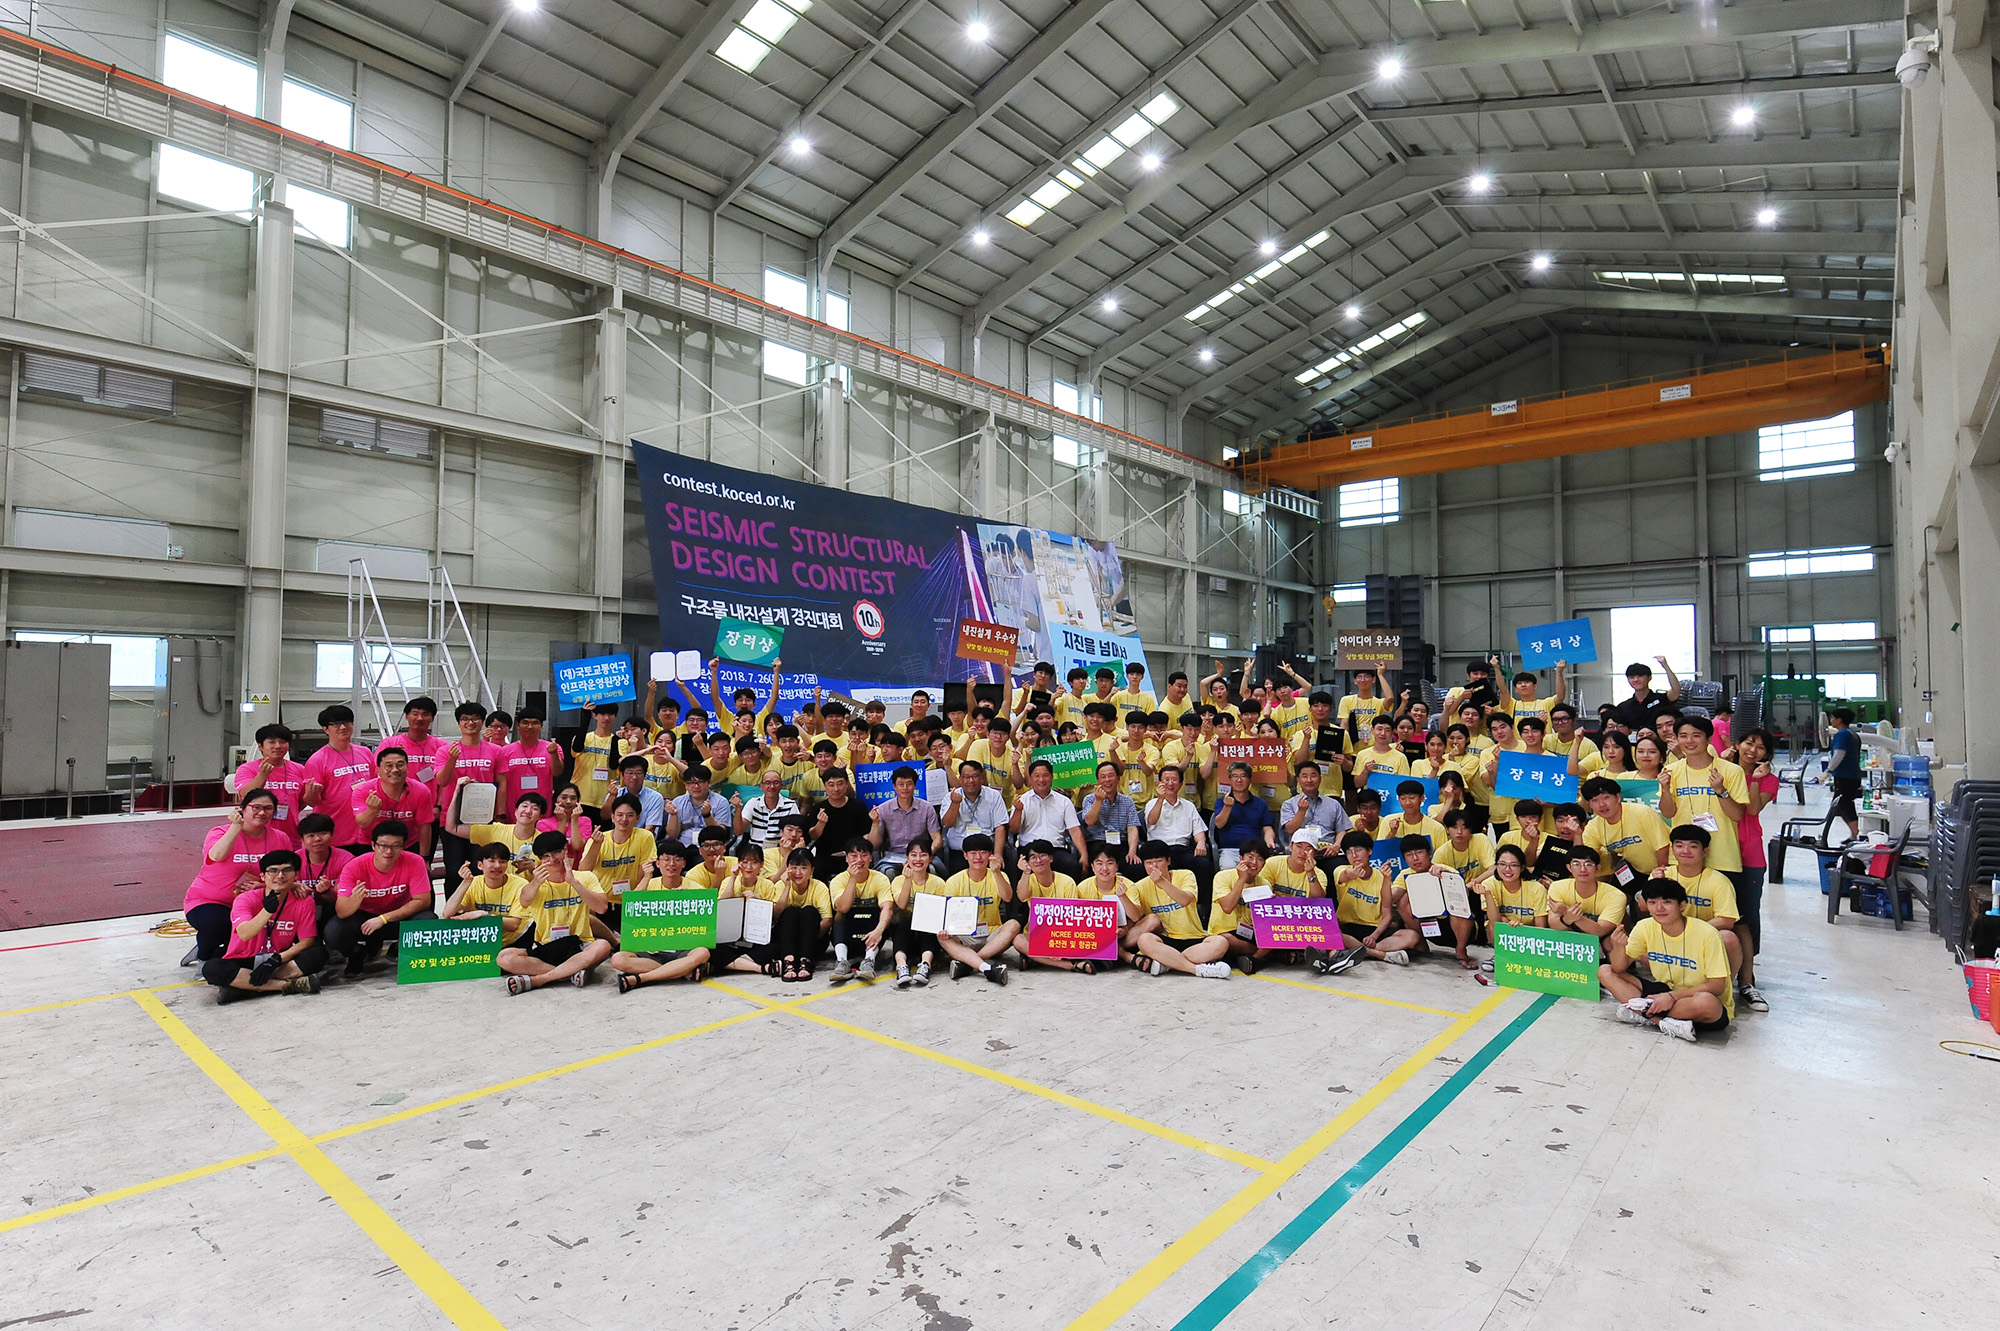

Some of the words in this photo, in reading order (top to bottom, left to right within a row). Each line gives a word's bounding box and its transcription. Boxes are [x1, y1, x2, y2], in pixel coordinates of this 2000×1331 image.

[663, 472, 796, 510] contest.koced.or.kr
[665, 502, 779, 549] SEISMIC
[789, 526, 932, 570] STRUCTURAL
[670, 540, 779, 584] DESIGN
[792, 562, 896, 596] CONTEST
[681, 594, 728, 620] 구조물
[730, 602, 789, 626] 내진설계
[790, 608, 844, 630] 경진대회
[962, 625, 992, 640] 내진설계
[994, 630, 1016, 644] 우수상
[1340, 636, 1372, 646] 아이디어
[1376, 635, 1400, 646] 우수상
[1062, 630, 1095, 655] 지진을
[1099, 640, 1127, 660] 넘어서
[560, 661, 627, 680] (재)국토교통연구
[561, 674, 630, 694] 인프라운영원장상
[793, 674, 818, 685] 27(금)
[585, 747, 610, 755] SESTE
[1220, 745, 1254, 758] 내진설계
[1258, 745, 1284, 758] 우수상
[408, 755, 435, 764] ESTEC
[455, 759, 491, 768] SESTEC
[509, 757, 546, 766] SESTEC
[334, 763, 370, 778] SESTEC
[1373, 764, 1394, 773] STEC
[233, 854, 265, 863] SEST
[602, 856, 636, 867] SESTEC
[544, 896, 582, 909] SESTEC
[1347, 888, 1379, 904] SESTEC
[1686, 896, 1711, 907] TEC
[1034, 904, 1114, 928] 행정안전부장관상
[1254, 904, 1333, 921] 국토교통부장관상
[632, 928, 647, 938] 상장
[650, 928, 658, 936] 및
[660, 927, 674, 936] 상금
[677, 925, 707, 935] 100만원
[1498, 933, 1595, 964] 지진방재연구센터장상
[410, 958, 427, 969] 상장
[429, 958, 438, 967] 및
[441, 956, 456, 966] 상금
[459, 954, 490, 964] 100만원
[1647, 952, 1697, 970] SESTEC
[1505, 962, 1522, 974] 상장
[1524, 965, 1533, 975] 및
[1535, 966, 1551, 978] 상금
[1554, 970, 1588, 984] 100만원
